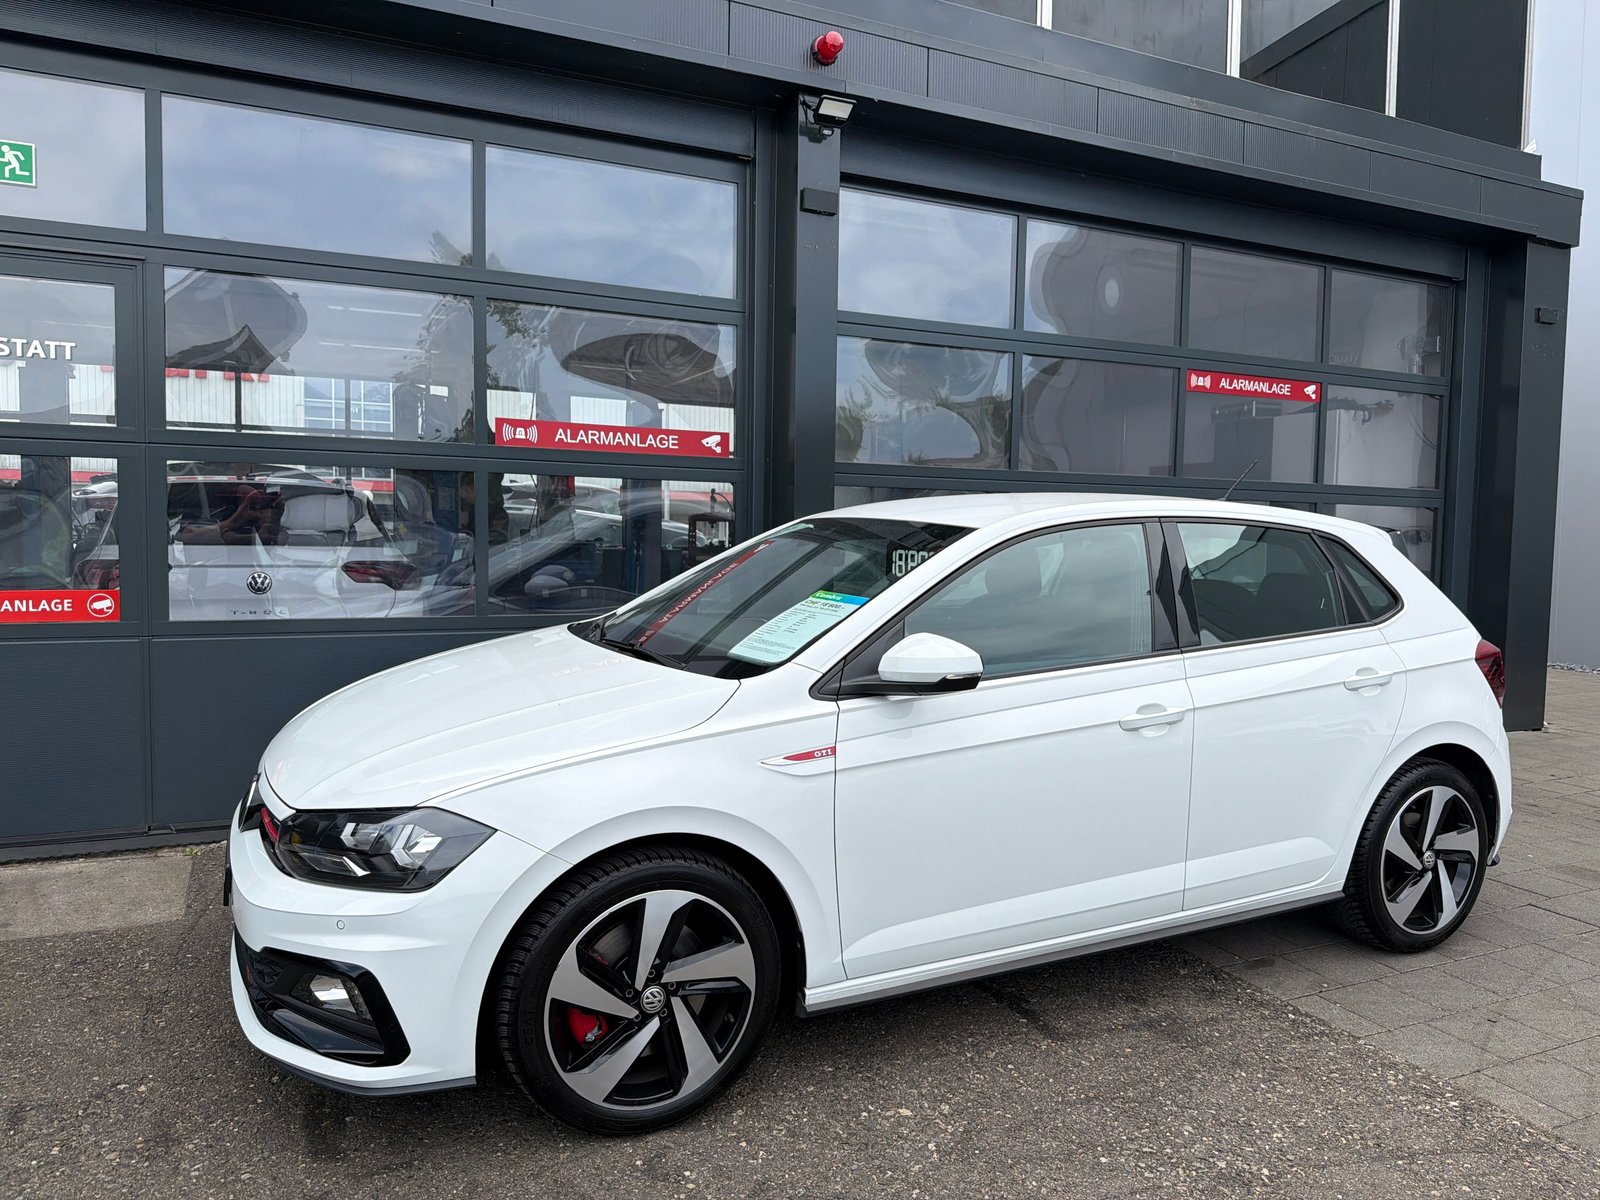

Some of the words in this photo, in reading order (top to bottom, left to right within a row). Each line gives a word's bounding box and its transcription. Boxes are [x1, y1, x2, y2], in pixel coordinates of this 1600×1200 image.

[0, 337, 76, 360] STATT
[1219, 378, 1291, 395] ALARMANLAGE
[555, 428, 678, 449] ALARMANLAGE
[0, 599, 73, 612] ANLAGE
[814, 749, 832, 758] GTI
